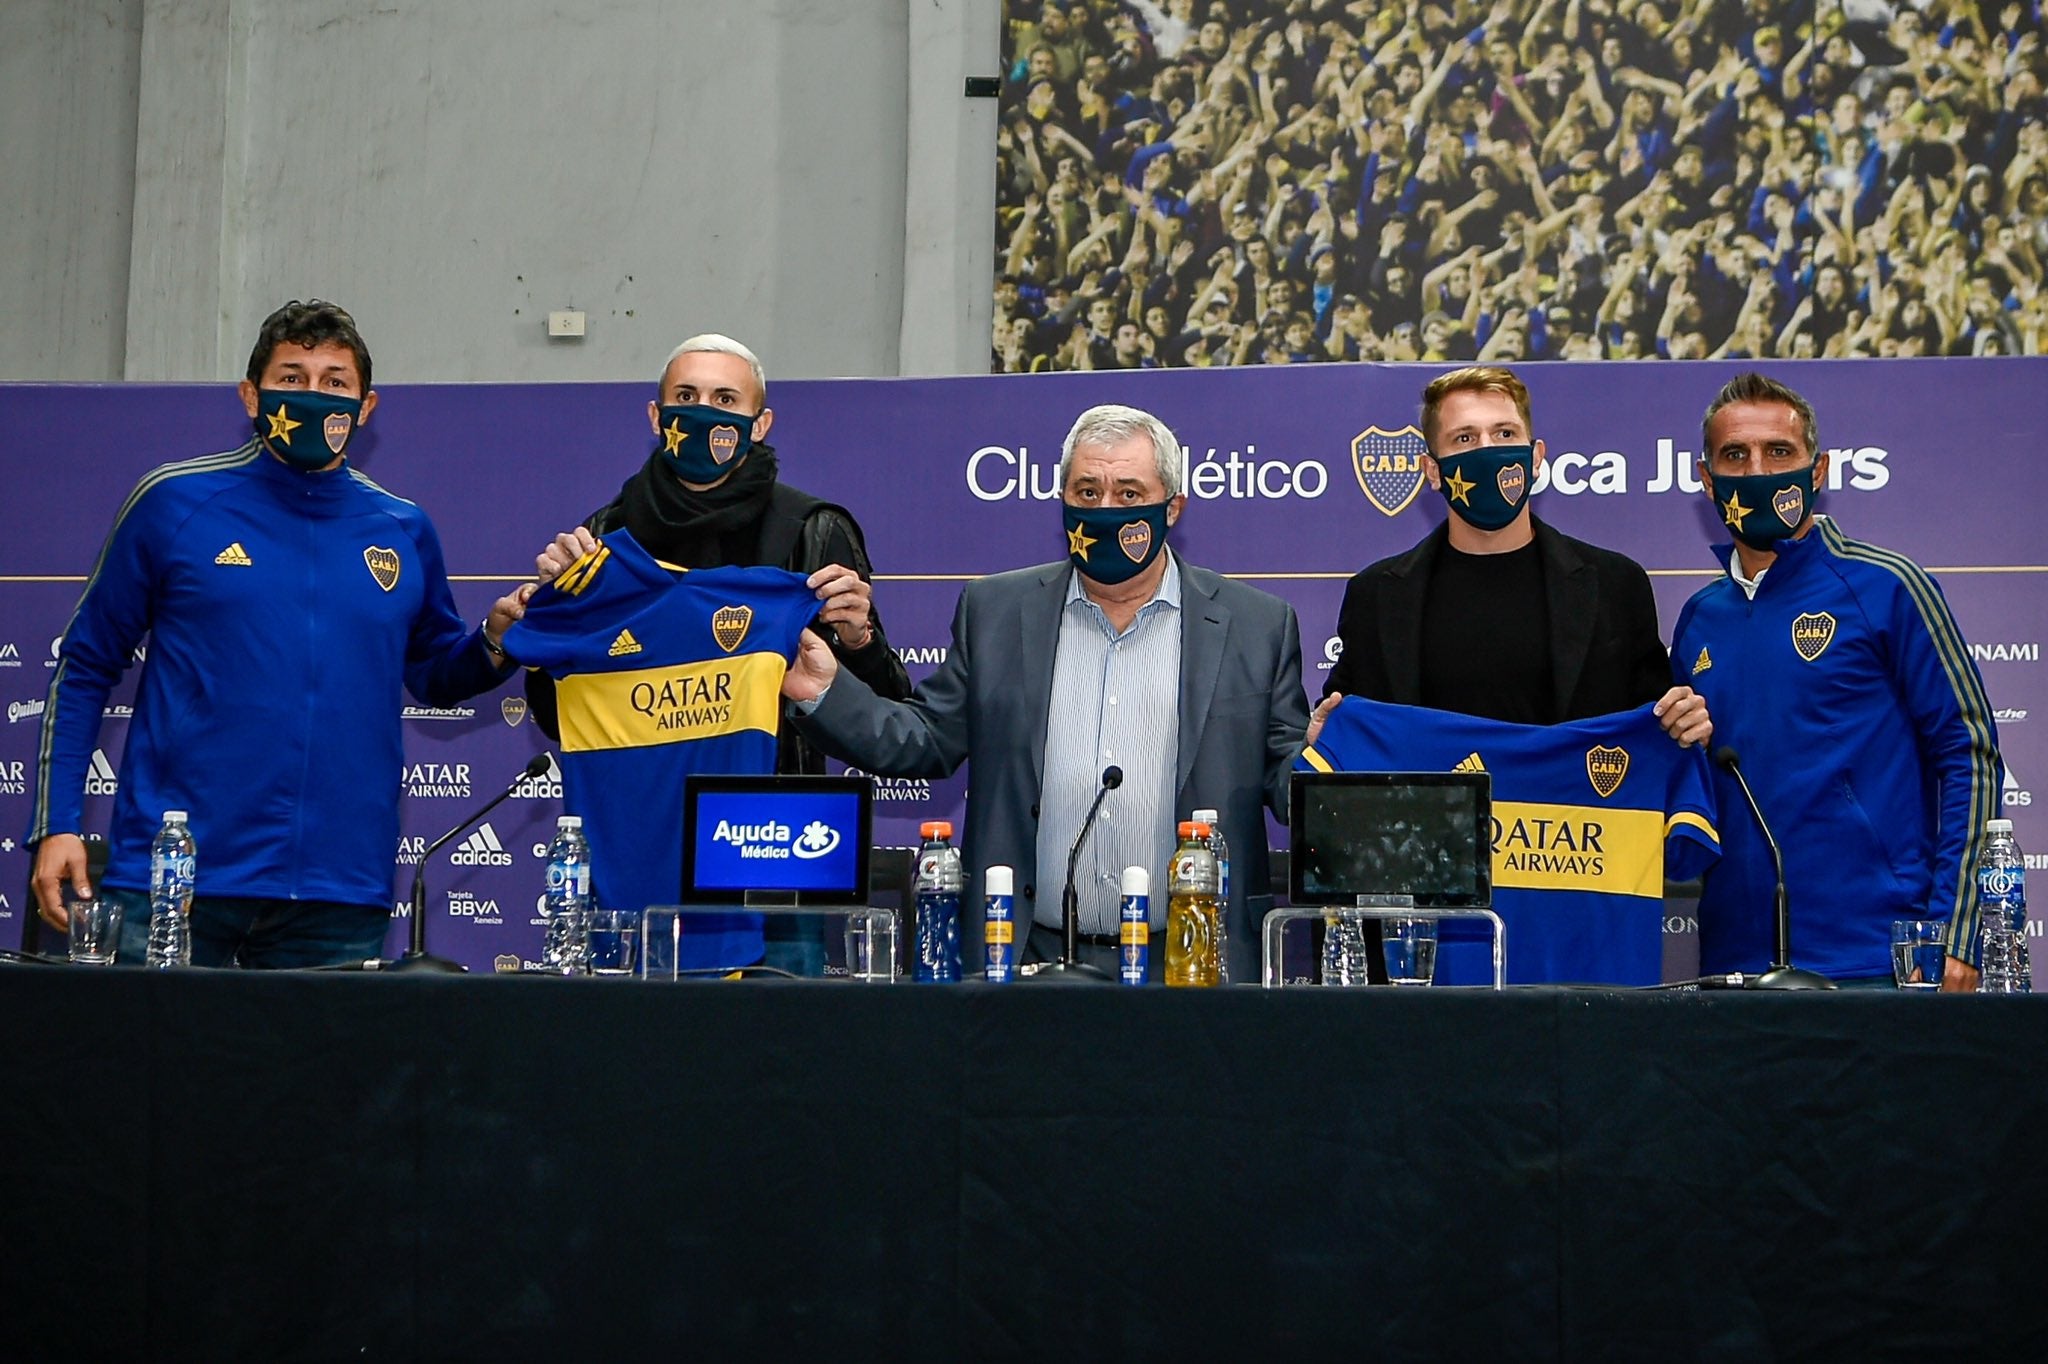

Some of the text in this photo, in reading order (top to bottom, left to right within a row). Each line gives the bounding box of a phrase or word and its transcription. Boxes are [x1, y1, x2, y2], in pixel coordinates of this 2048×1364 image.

[1361, 455, 1421, 473] CABJ
[966, 445, 1328, 500] Clu lético
[1454, 481, 1464, 496] 70
[1778, 497, 1800, 513] CABJ
[1728, 506, 1739, 521] 70
[1073, 536, 1084, 550] 70
[1123, 532, 1148, 545] CABJ
[716, 620, 744, 630] CABJ
[1796, 628, 1828, 639] CABJ
[1970, 643, 2039, 661] NAMI
[631, 672, 732, 717] QATAR
[8, 699, 45, 723] Quilm
[656, 704, 730, 731] AIRWAYS
[1592, 763, 1621, 774] CABJ
[408, 784, 471, 798] AIRWAYS
[508, 782, 564, 798] adida
[712, 820, 790, 846] Ayuda
[450, 850, 512, 866] adidas
[741, 844, 790, 859] Médica
[1503, 852, 1604, 876] AIRWAYS
[447, 891, 474, 900] Tarjeta
[449, 900, 500, 916] BBVA
[473, 917, 503, 925] Xeneize
